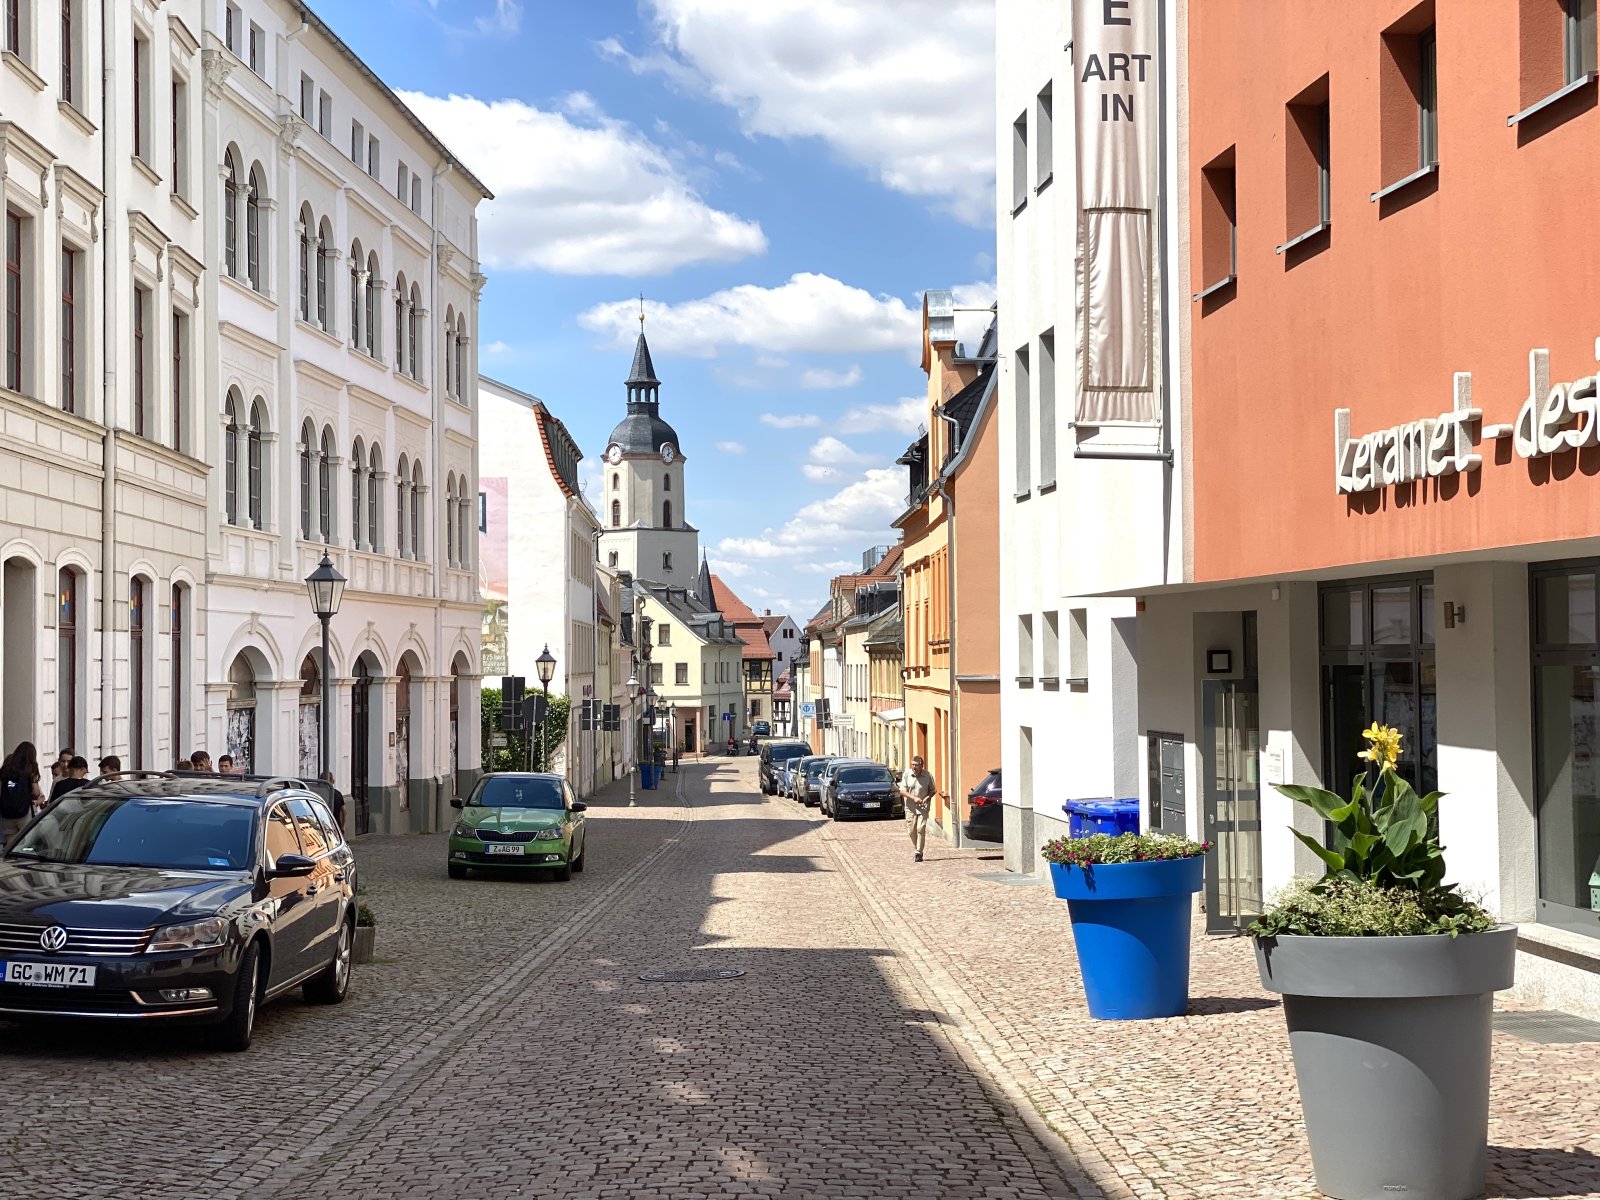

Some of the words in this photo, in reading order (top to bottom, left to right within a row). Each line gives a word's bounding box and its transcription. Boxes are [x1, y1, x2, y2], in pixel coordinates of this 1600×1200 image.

[1081, 53, 1151, 82] ART
[1101, 93, 1134, 122] IN
[11, 964, 33, 980] GC
[44, 965, 65, 982] WM
[69, 967, 88, 983] 71
